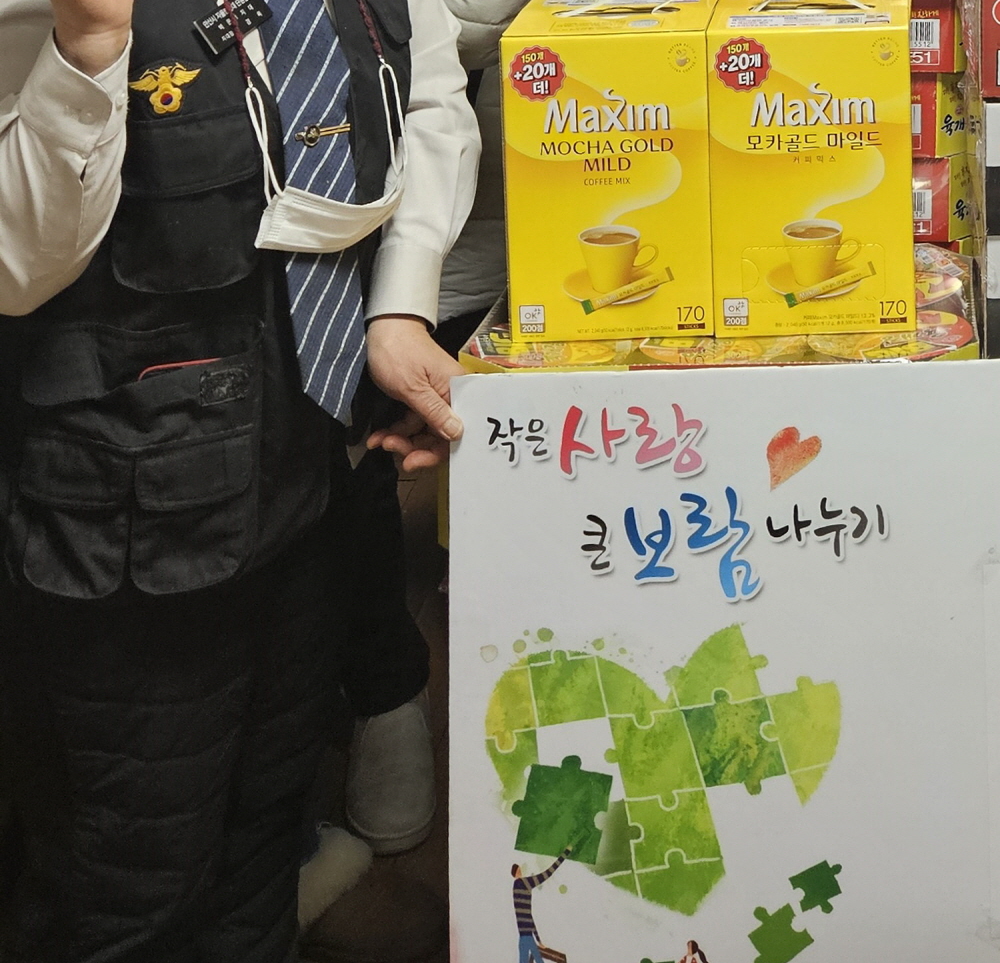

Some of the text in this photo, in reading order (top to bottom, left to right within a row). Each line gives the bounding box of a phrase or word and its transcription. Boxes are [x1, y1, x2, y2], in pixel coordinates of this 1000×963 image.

[726, 42, 749, 55] 150개
[521, 50, 544, 64] 150개
[719, 52, 762, 73] +20개
[910, 50, 931, 64] 51
[513, 62, 557, 82] +20개
[738, 71, 755, 87] 더!
[532, 81, 550, 96] 더!
[544, 89, 671, 133] Maxim
[750, 82, 877, 128] Maxim
[540, 137, 674, 156] MOCHA GOLD
[746, 130, 883, 153] 모카골드 마일드
[583, 157, 631, 172] MILD
[583, 177, 631, 186] COFFEE MIX
[676, 305, 706, 323] 170
[727, 304, 742, 313] OK
[879, 300, 907, 316] 170
[524, 312, 538, 321] OK
[486, 402, 706, 476] 작은 사랑
[581, 486, 887, 599] 큰 보람 나누기
